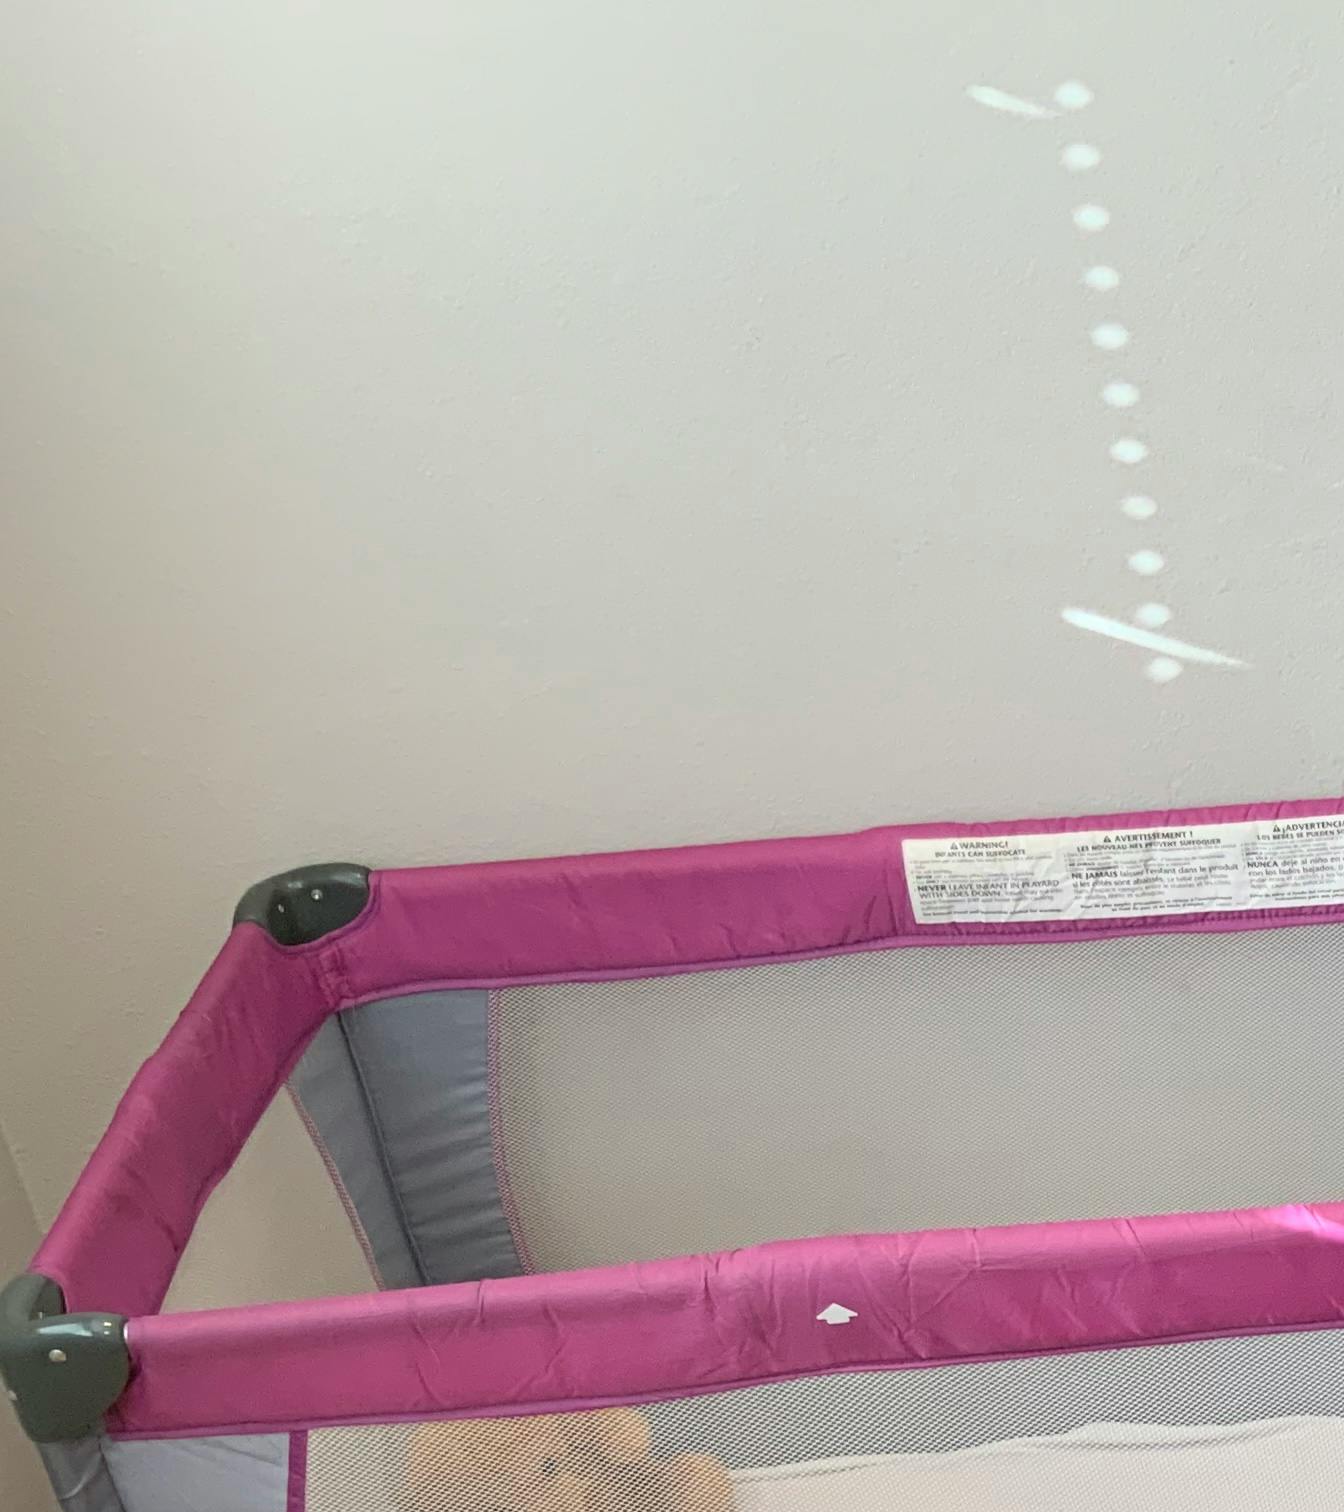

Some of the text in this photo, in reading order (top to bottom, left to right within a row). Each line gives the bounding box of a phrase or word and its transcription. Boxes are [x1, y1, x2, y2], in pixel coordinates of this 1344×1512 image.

[1115, 832, 1186, 843] AVERTISSEMENT
[959, 840, 1009, 850] WARNING!
[1247, 860, 1279, 869] NUNCA
[1071, 872, 1083, 880] NE
[1086, 870, 1118, 880] JAMAIS
[1178, 866, 1197, 874] dans
[1208, 863, 1238, 873] produit
[917, 884, 946, 892] NEVER
[976, 881, 1007, 890] INFANT
[919, 891, 943, 899] WITH
